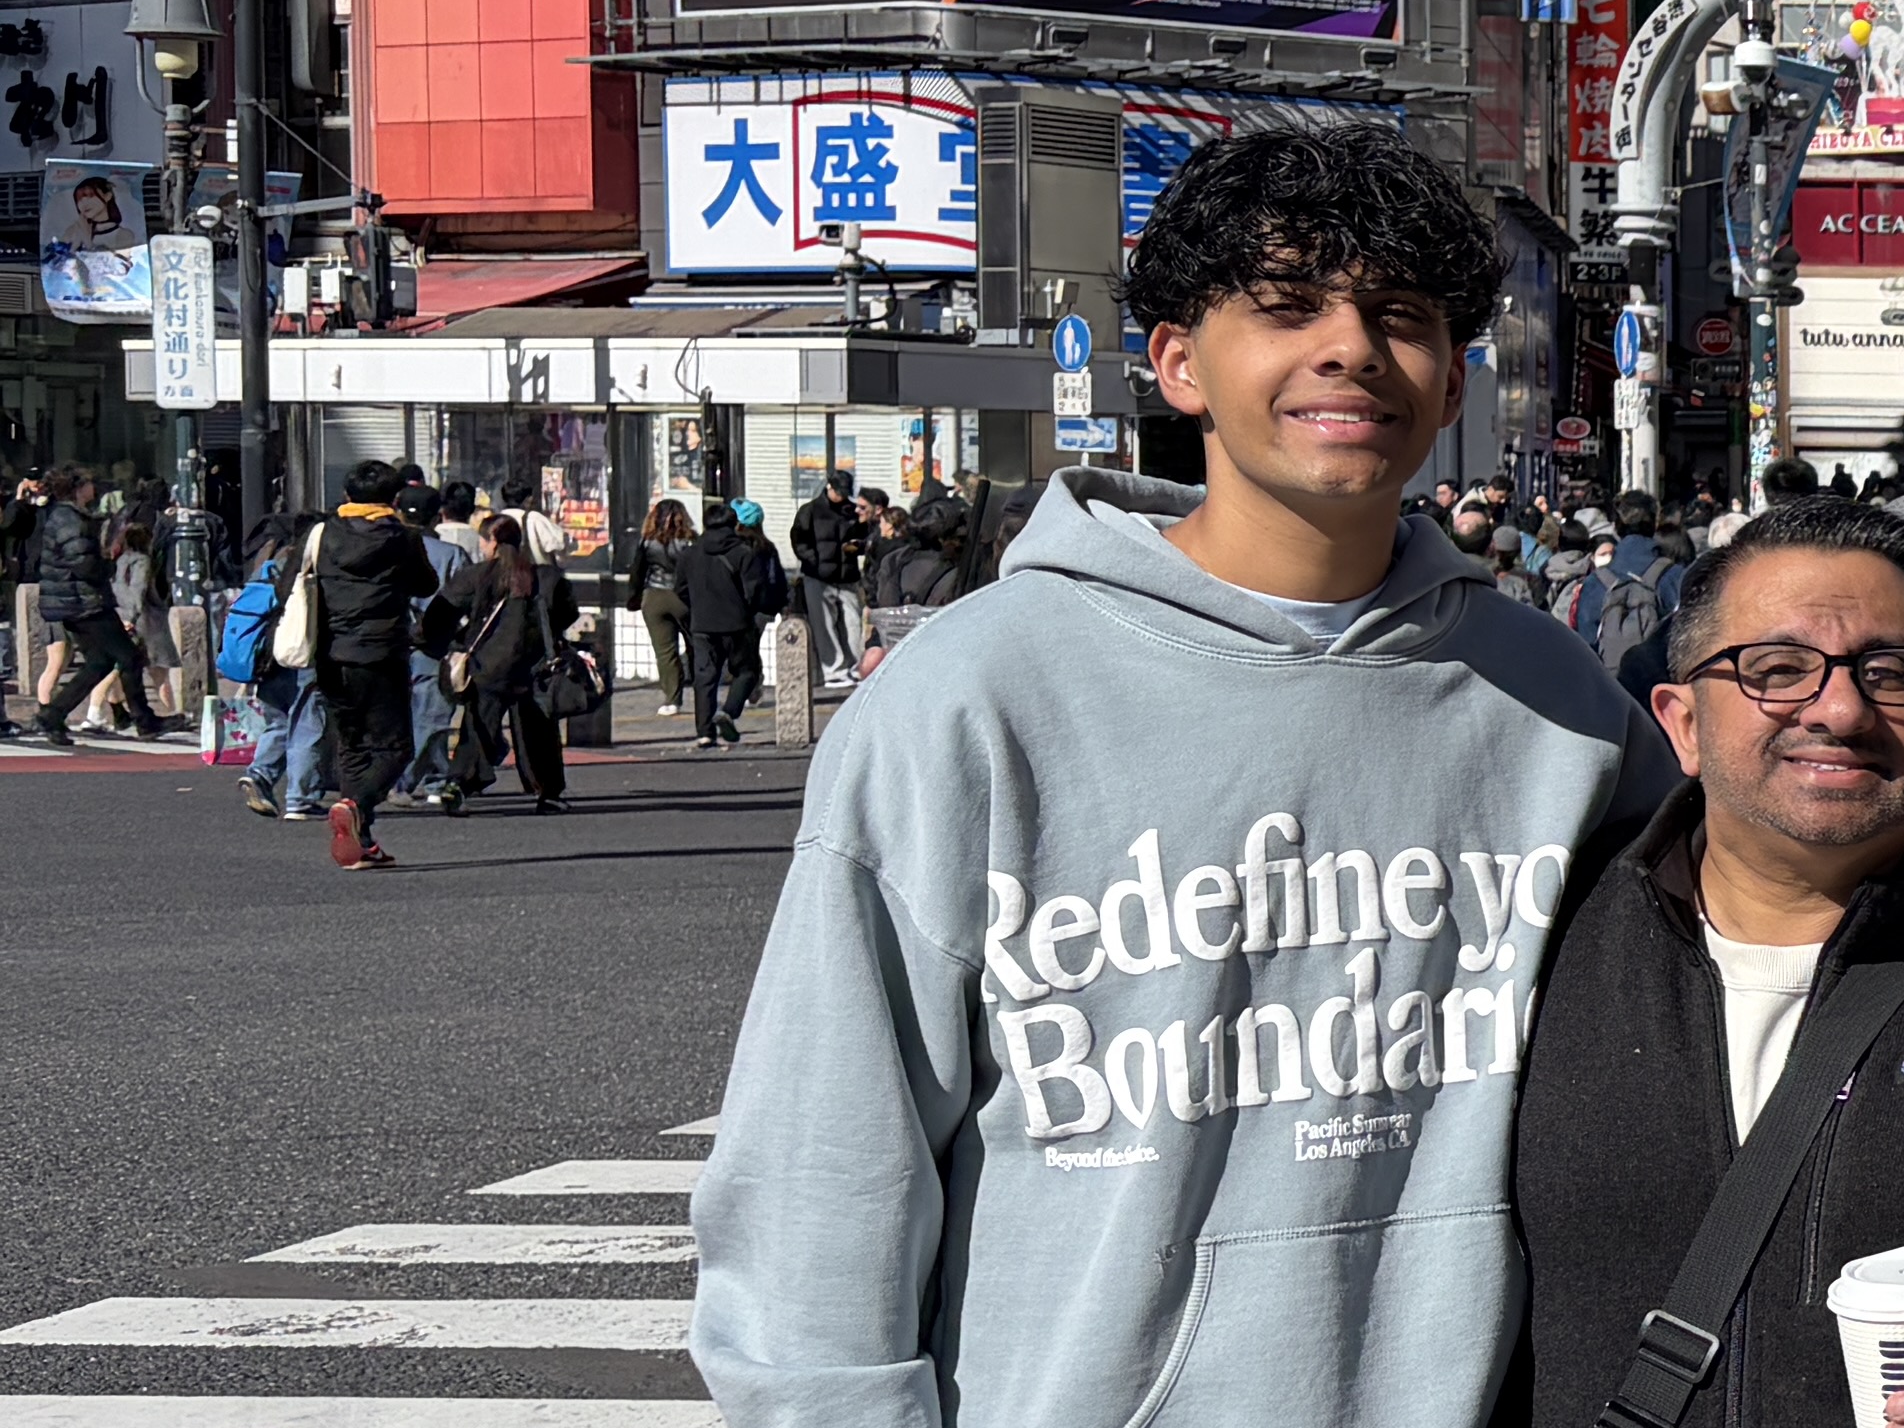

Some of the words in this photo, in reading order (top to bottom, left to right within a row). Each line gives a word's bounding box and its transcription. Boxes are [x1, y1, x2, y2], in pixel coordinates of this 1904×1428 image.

[163, 250, 192, 380] 文化村通り
[1800, 327, 1849, 348] tutu
[981, 812, 1449, 1003] Redefine
[997, 947, 1538, 1140] Boundari
[1294, 1116, 1352, 1141] Pacific
[1045, 1146, 1103, 1172] Beyond
[1294, 1140, 1328, 1162] Los
[1388, 1129, 1412, 1149] CA
